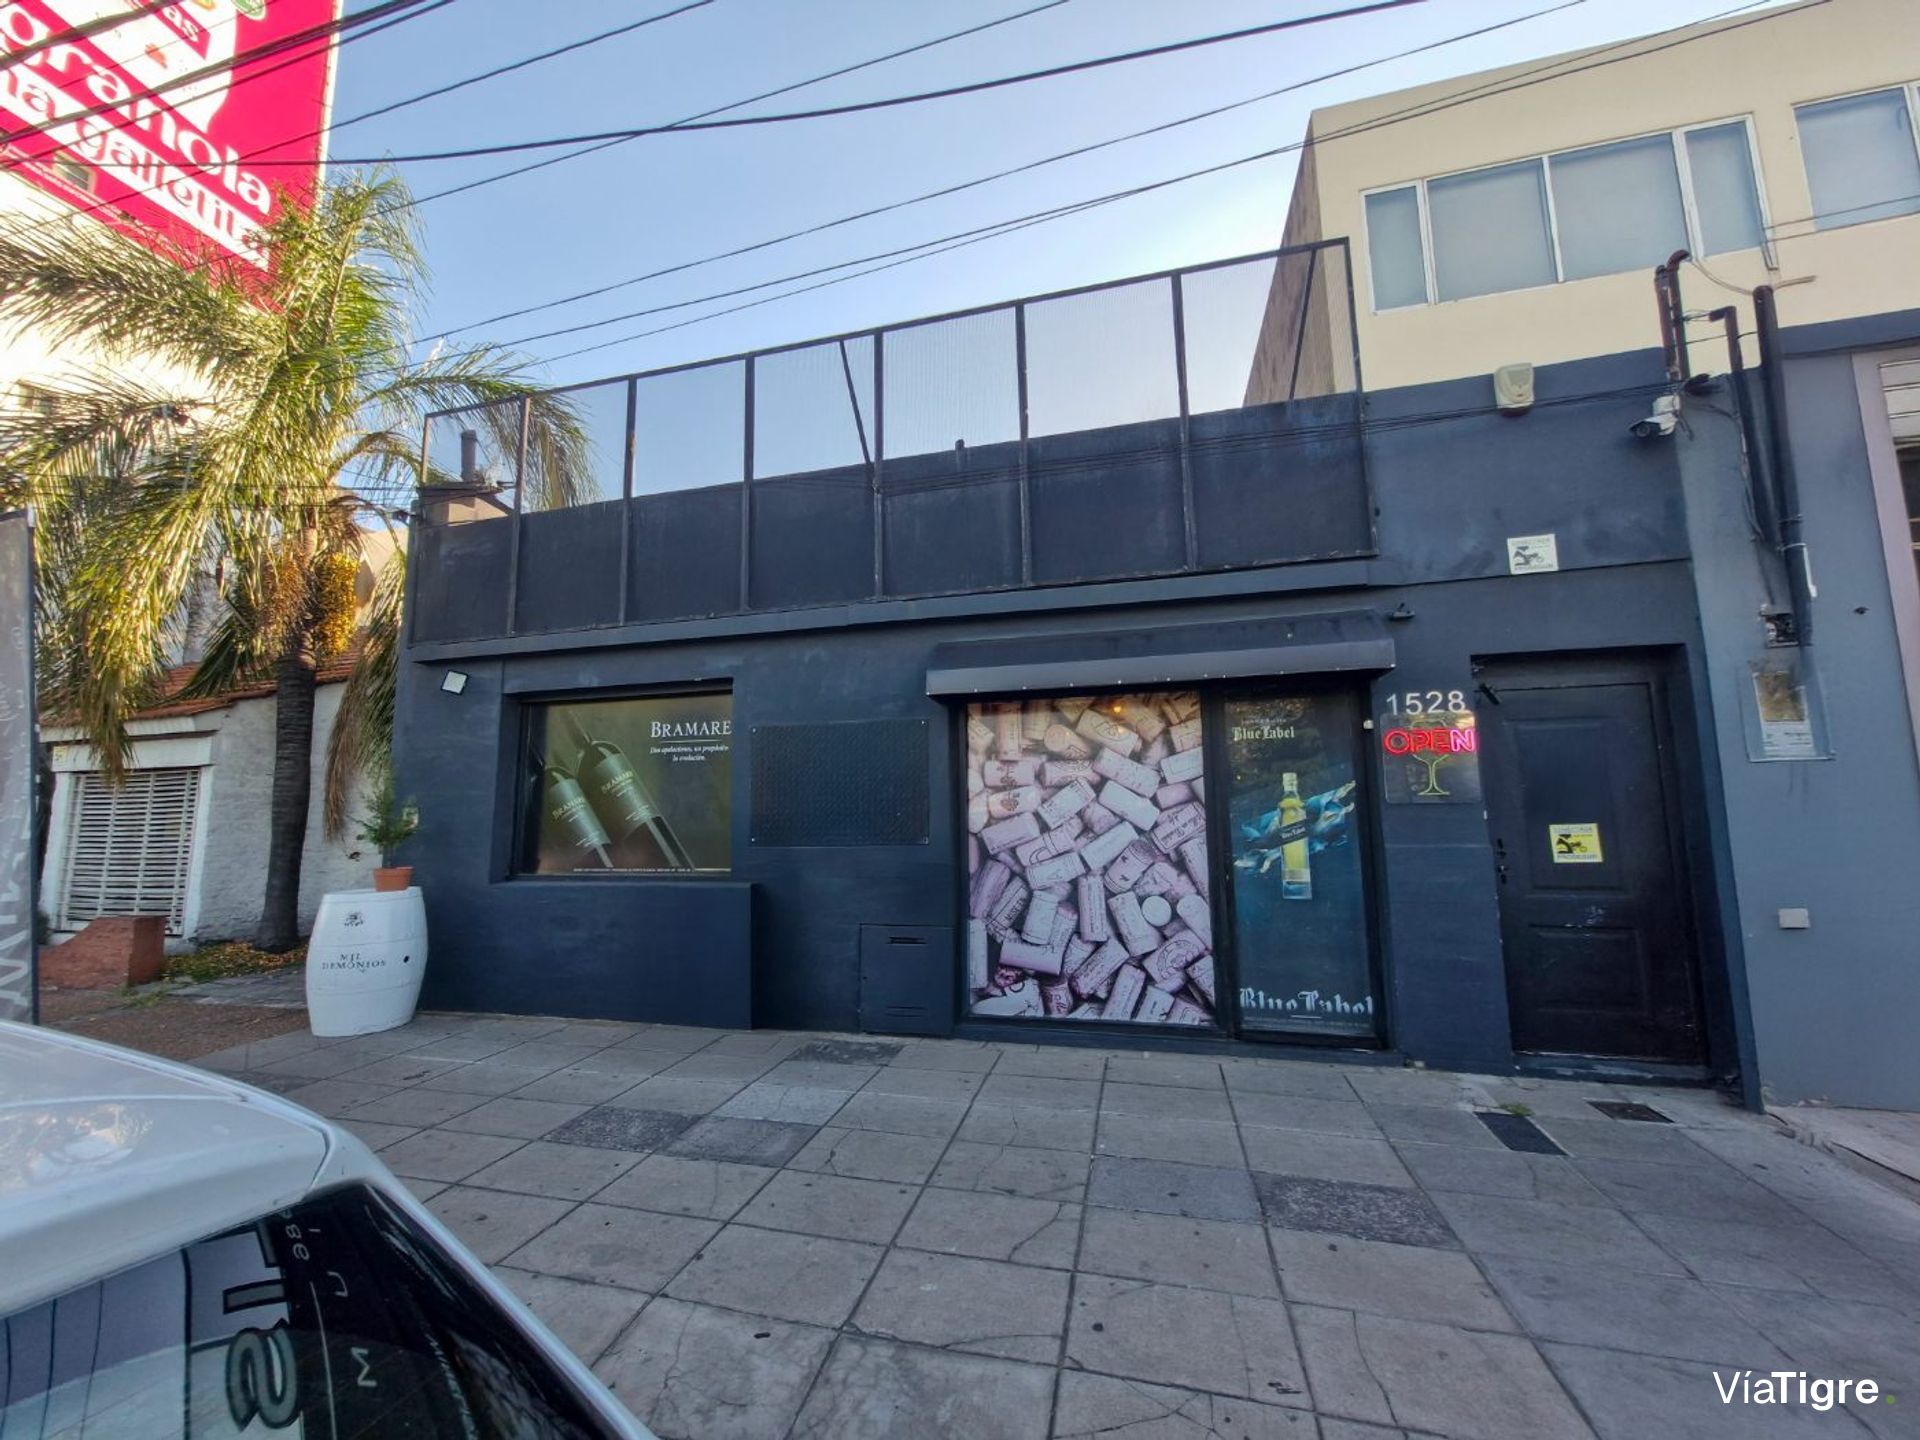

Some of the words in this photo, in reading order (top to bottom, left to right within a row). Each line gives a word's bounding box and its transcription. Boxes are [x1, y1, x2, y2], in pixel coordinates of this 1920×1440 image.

[1386, 690, 1466, 716] 1528
[650, 720, 733, 738] BRAMARE
[1383, 727, 1477, 756] OPEN
